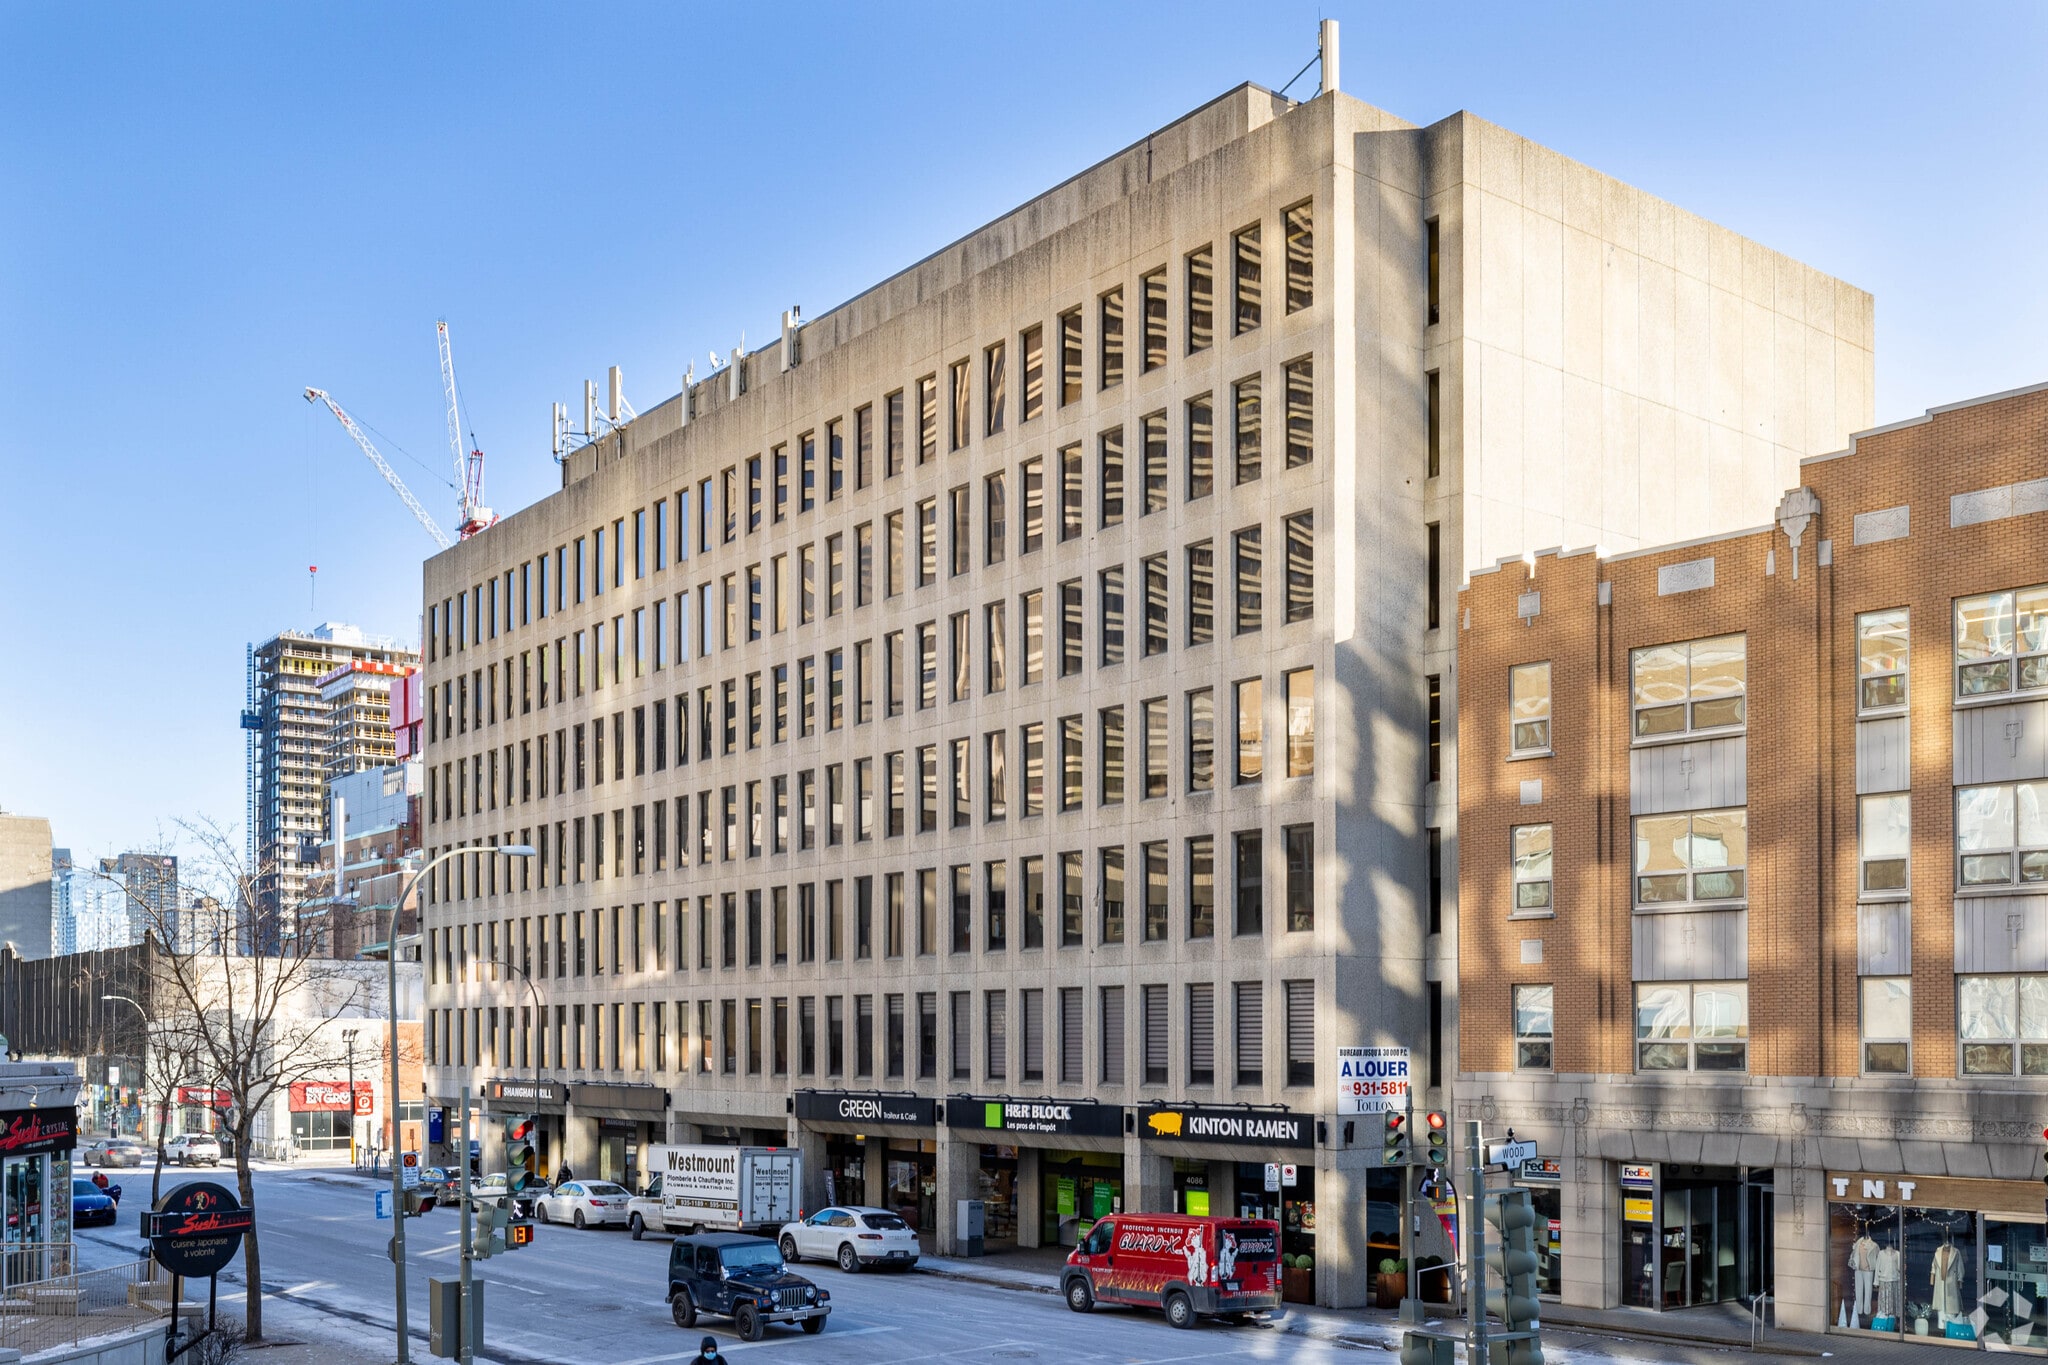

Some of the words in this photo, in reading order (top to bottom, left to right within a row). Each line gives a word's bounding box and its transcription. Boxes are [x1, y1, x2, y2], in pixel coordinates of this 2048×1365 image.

[1339, 1048, 1363, 1057] BUREAUX
[1383, 1048, 1390, 1057] 30
[1356, 1060, 1408, 1077] LOUER
[503, 1086, 534, 1098] SHANGHAI
[1353, 1081, 1408, 1096] 931-5811
[305, 1092, 322, 1104] EN
[1005, 1103, 1031, 1119] H&R
[1032, 1105, 1072, 1120] BLOCK
[1006, 1121, 1016, 1129] Les
[1028, 1122, 1036, 1130] de
[1189, 1116, 1242, 1137] KINTON
[1246, 1119, 1298, 1140] RAMEN
[6, 1114, 41, 1150] Sushi
[1502, 1146, 1525, 1159] WOOD
[668, 1151, 735, 1174] Westmount
[1525, 1160, 1560, 1172] FedEx
[1624, 1167, 1650, 1178] FedEx
[667, 1174, 692, 1183] Plomberie
[698, 1176, 724, 1185] Chauffage
[725, 1177, 735, 1185] Inc.
[1186, 1176, 1203, 1185] 4086
[178, 1212, 221, 1235] Sushi
[1122, 1223, 1154, 1233] PROTECTION
[1157, 1226, 1184, 1235] INCENDIE
[514, 1226, 526, 1243] 13
[170, 1240, 196, 1249] Cuisine
[197, 1237, 228, 1247] Japonaise
[1119, 1232, 1182, 1254] GUARD-X
